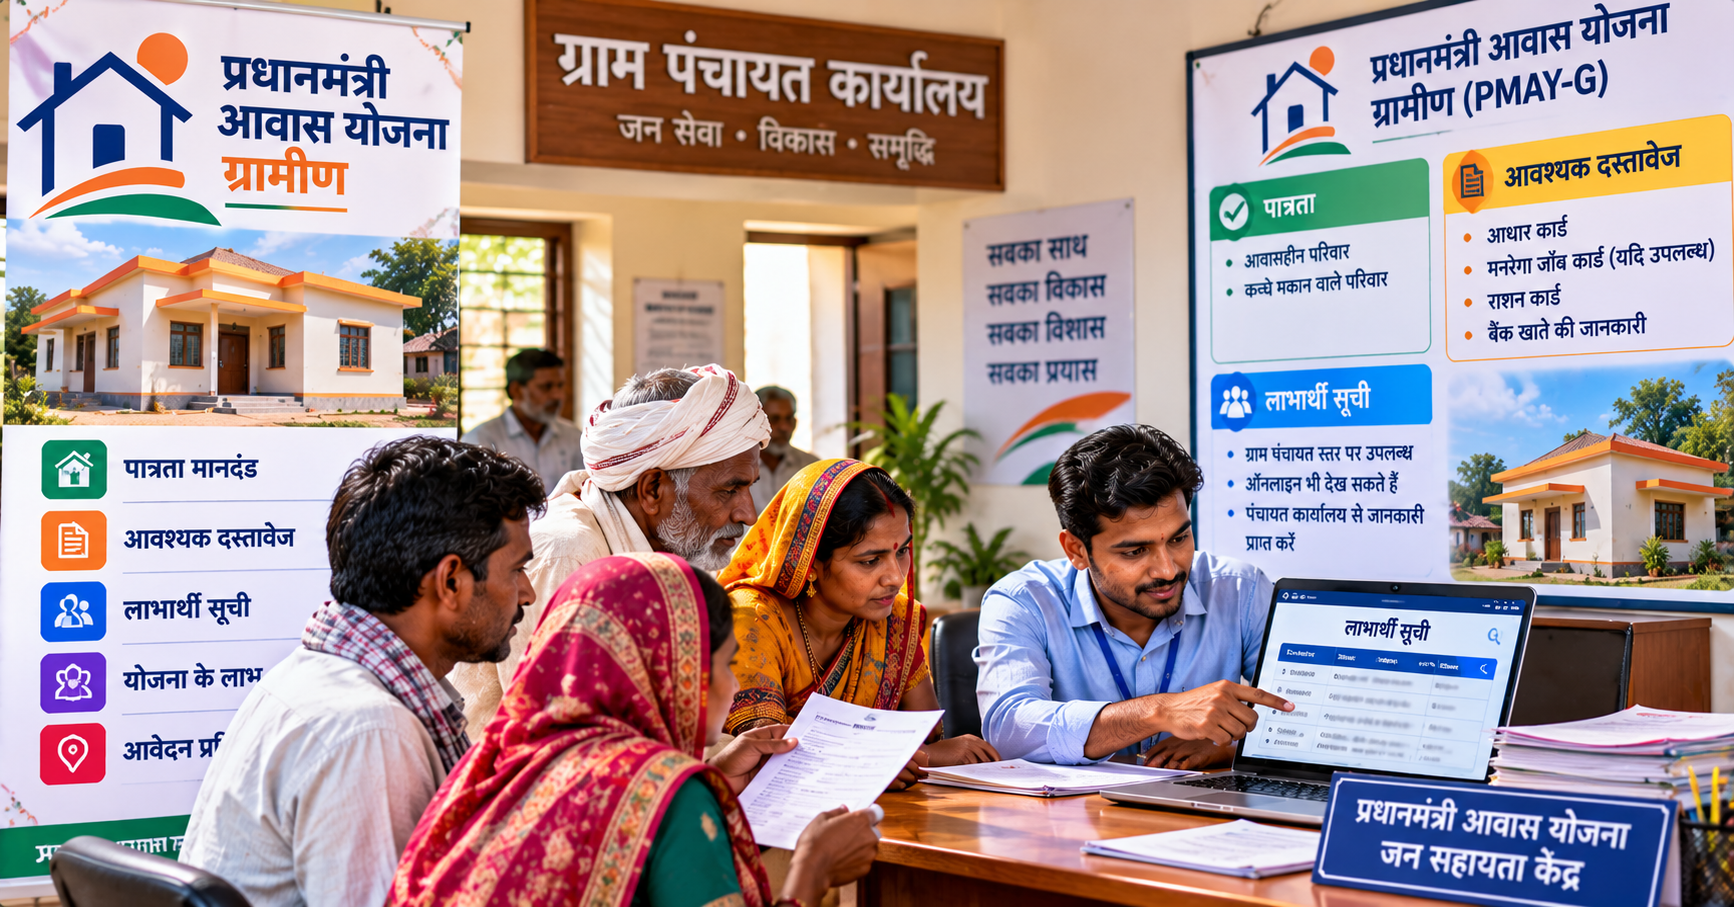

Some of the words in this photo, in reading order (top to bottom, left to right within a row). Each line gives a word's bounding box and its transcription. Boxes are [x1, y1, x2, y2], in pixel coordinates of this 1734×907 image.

[1370, 28, 1481, 83] प्रधानमंत्री
[1488, 20, 1572, 60] आवास
[1579, 2, 1669, 44] योजना
[220, 53, 390, 98] प्रधानमंत्री
[555, 34, 649, 89] ग्राम
[663, 30, 814, 102] पंचायत
[827, 51, 988, 118] कार्यालय
[1370, 82, 1454, 127] ग्रामीण
[1464, 59, 1607, 117] (PMAY-G)
[217, 104, 334, 143] आवास
[343, 101, 449, 149] योजना
[617, 114, 663, 142] जन
[672, 110, 723, 146] सेवा
[757, 116, 836, 155] विकास
[221, 146, 348, 194] ग्रामीण
[1504, 157, 1590, 186] आवश्यक
[1596, 140, 1681, 177] दस्तावेज
[1263, 193, 1315, 217] पात्रता
[1487, 224, 1531, 242] आधार
[1536, 214, 1567, 238] कार्ड
[1047, 234, 1088, 259] साथ
[1244, 244, 1305, 267] आवासहीन
[1308, 241, 1349, 261] परिवार
[1487, 254, 1532, 276] मनरेगा
[1536, 250, 1567, 271] जॉब
[1572, 245, 1604, 268] कार्ड
[1609, 242, 1644, 269] (यदि
[1044, 270, 1106, 300] विकास
[1276, 278, 1311, 294] मकान
[1315, 270, 1341, 291] वाले
[1345, 268, 1388, 288] परिवार
[1487, 291, 1525, 309] राशन
[1529, 283, 1561, 305] कार्ड
[1487, 320, 1513, 342] बैंक
[1517, 317, 1549, 340] खाते
[1554, 316, 1574, 338] की
[1579, 311, 1646, 336] जानकारी
[1045, 358, 1097, 382] प्रयास
[1265, 381, 1328, 410] लाभार्थी
[1332, 380, 1370, 416] सूची
[123, 459, 185, 477] पात्रता
[190, 453, 258, 479] मानदंड
[1245, 447, 1267, 461] ग्राम
[1317, 446, 1341, 460] स्तर
[1344, 446, 1361, 460] पर
[1245, 472, 1302, 493] ऑनलाइन
[1305, 471, 1320, 491] भी
[1324, 471, 1347, 492] देख
[1351, 472, 1385, 491] सकते
[1388, 470, 1398, 493] हैं
[1245, 502, 1289, 521] पंचायत
[1292, 502, 1346, 522] कार्यालय
[1350, 503, 1363, 522] से
[1367, 503, 1424, 523] जानकारी
[124, 529, 211, 548] आवश्यक
[216, 521, 295, 549] दस्तावेज
[1275, 532, 1295, 550] करें
[123, 592, 201, 619] लाभार्थी
[206, 591, 251, 624] सूची
[1345, 617, 1398, 638] लाभार्थी
[1399, 619, 1430, 645] सूची
[123, 664, 188, 690] योजना
[193, 662, 214, 687] के
[220, 668, 262, 687] लाभ
[123, 734, 193, 760] आवेदन
[1355, 797, 1457, 830] प्रधानमंत्री
[1462, 809, 1542, 840] आवास
[1548, 808, 1631, 849] योजना
[1381, 840, 1423, 869] जन
[1429, 845, 1528, 881] सहायता
[1534, 847, 1584, 890] केंद्र
